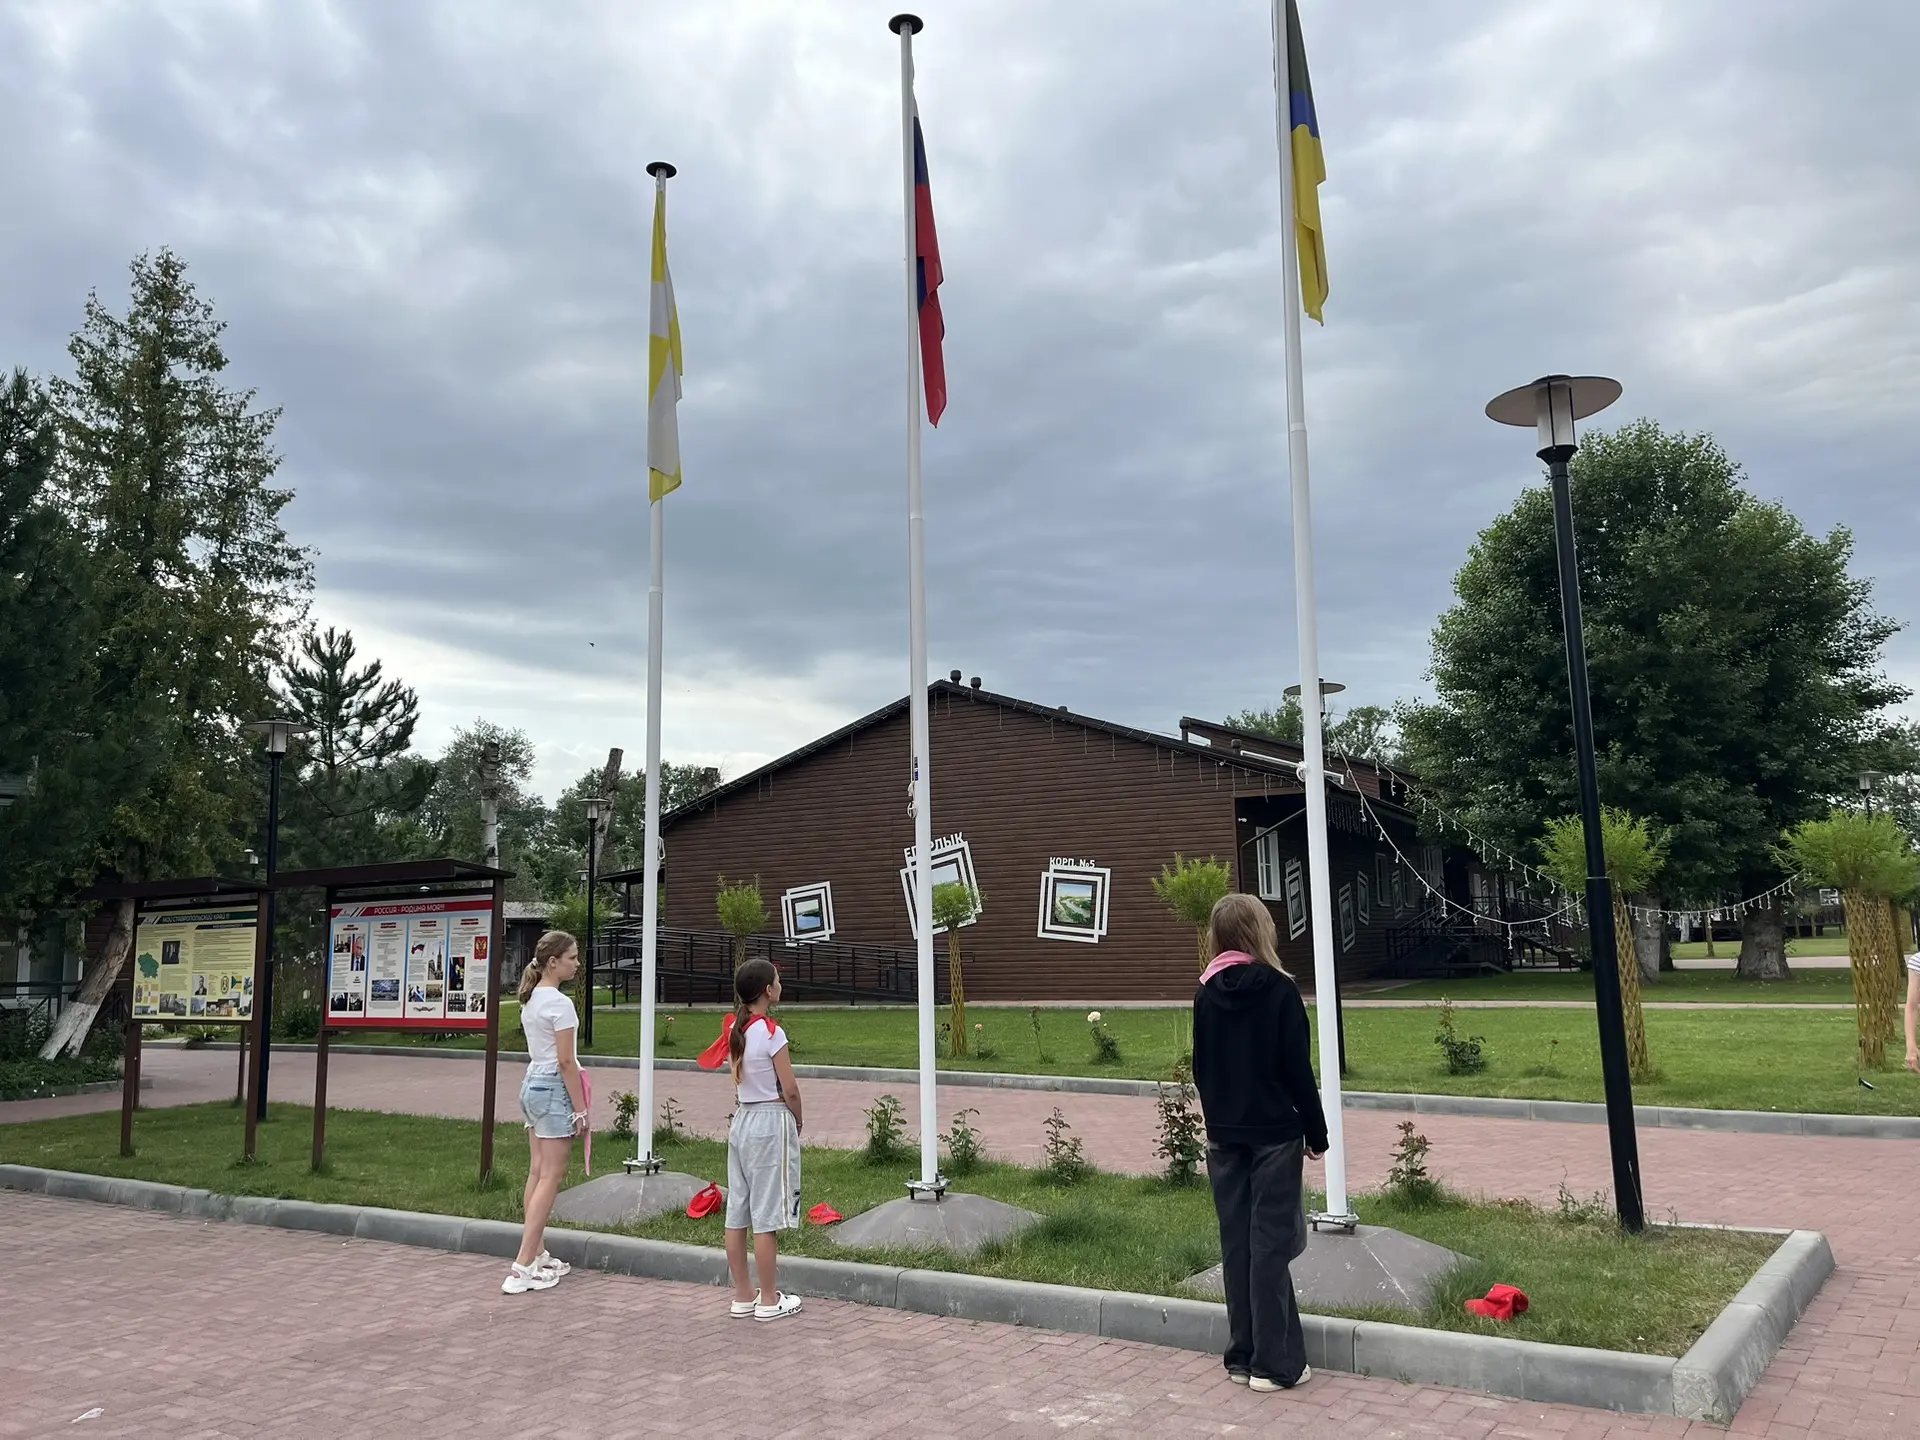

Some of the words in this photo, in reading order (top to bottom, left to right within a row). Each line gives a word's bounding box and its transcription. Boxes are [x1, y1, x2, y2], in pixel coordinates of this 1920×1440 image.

[903, 831, 964, 858] ЕГЛЫК
[1049, 856, 1077, 867] КОРП.
[1079, 858, 1096, 868] №5
[374, 906, 397, 915] РОССИЯ
[401, 904, 426, 914] РОДИНА
[787, 1302, 802, 1314] cro
